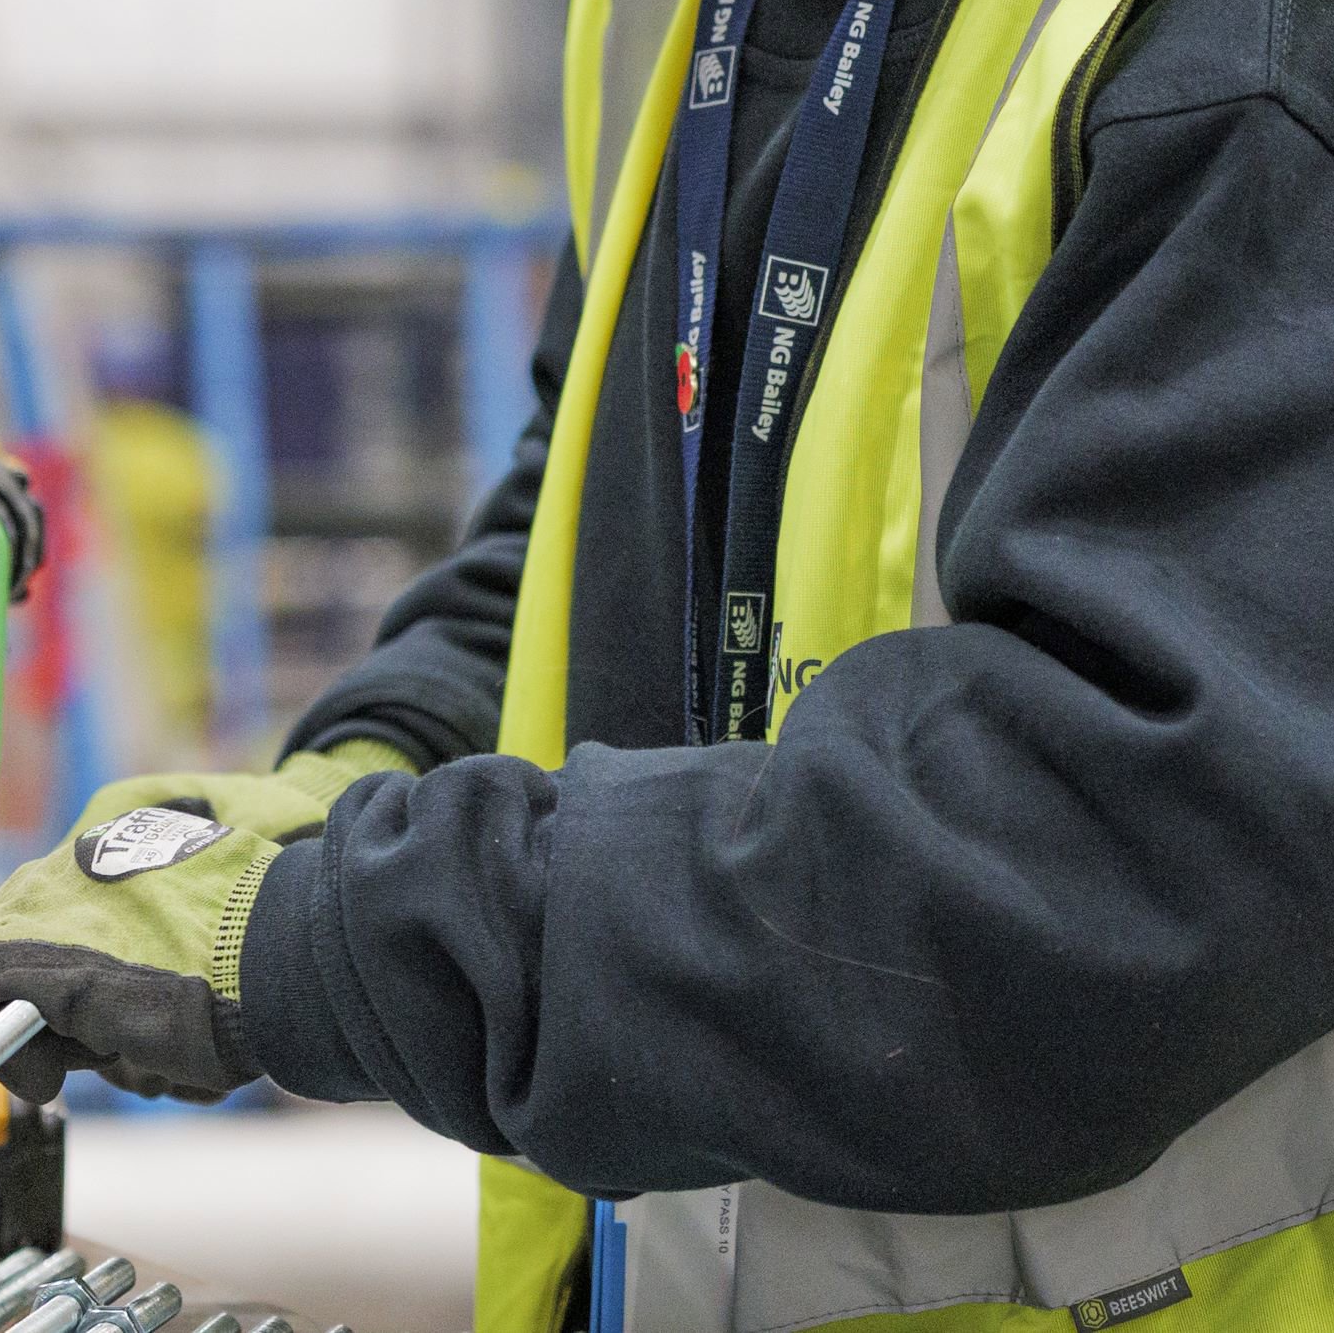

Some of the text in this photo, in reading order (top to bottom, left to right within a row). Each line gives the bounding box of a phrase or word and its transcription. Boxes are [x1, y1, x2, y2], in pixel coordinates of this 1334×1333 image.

[711, 8, 731, 42] NG
[822, 2, 874, 116] NG Bailey
[752, 327, 796, 442] NG Bailey
[729, 662, 746, 740] NG Bai
[719, 1198, 731, 1235] PASS
[718, 1240, 729, 1254] 10
[1109, 1277, 1178, 1316] BEESWIFT
